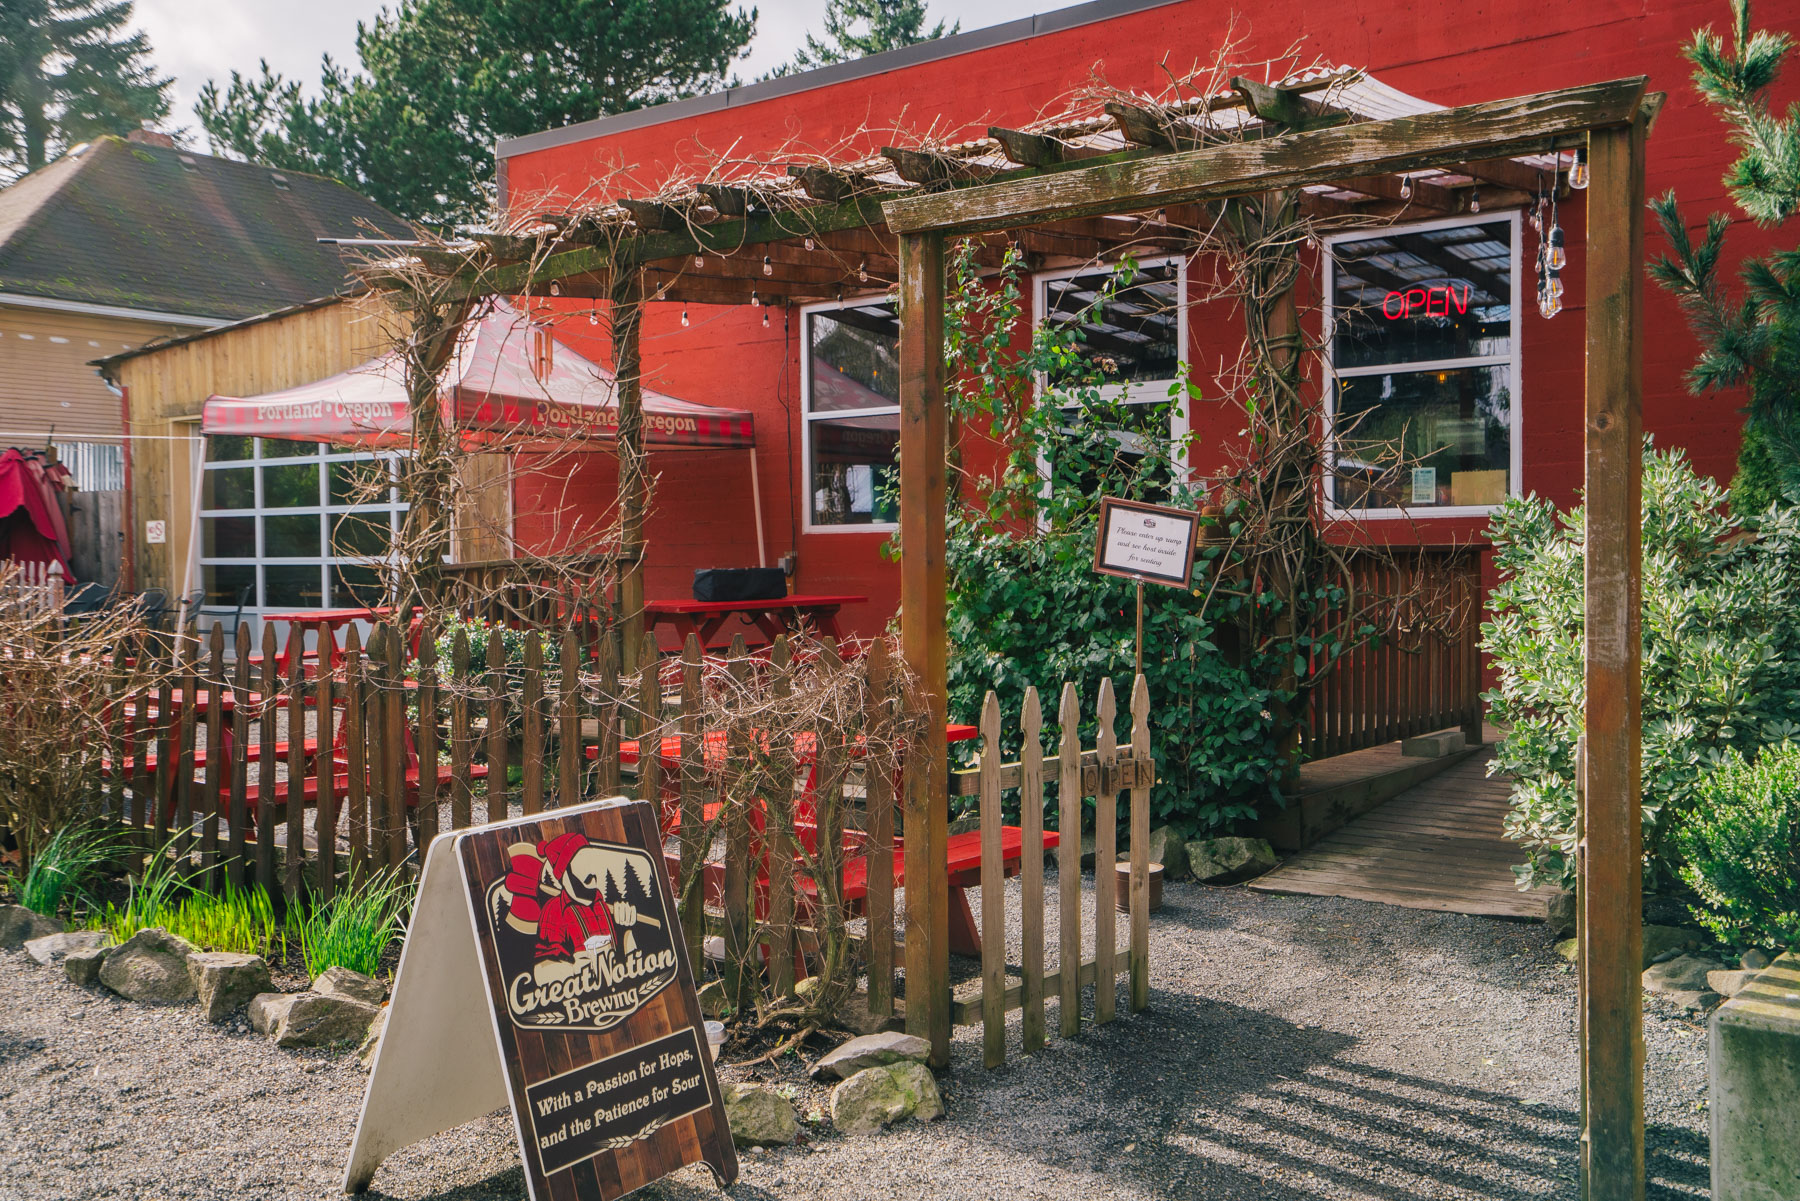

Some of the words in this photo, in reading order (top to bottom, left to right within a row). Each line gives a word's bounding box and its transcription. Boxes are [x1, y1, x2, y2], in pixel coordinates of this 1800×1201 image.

[1383, 285, 1468, 320] OPEN
[257, 401, 322, 420] Portland
[335, 402, 392, 423] Oregon
[537, 402, 619, 427] Portland
[641, 411, 697, 435] regon
[1116, 527, 1138, 537] Please
[1139, 532, 1154, 540] enter
[1165, 538, 1182, 547] ramp
[1142, 544, 1157, 553] host
[1157, 548, 1177, 556] inside
[1127, 553, 1138, 562] for
[1140, 557, 1162, 567] seating
[1086, 763, 1153, 792] OPEN
[510, 964, 596, 1015] Great
[592, 949, 677, 991] Notion
[563, 987, 640, 1025] Brewing
[536, 1091, 572, 1117] With
[574, 1090, 584, 1103] a
[586, 1069, 638, 1099] Passion
[639, 1061, 657, 1078] for
[658, 1048, 694, 1071] Hops,
[540, 1123, 568, 1149] and
[570, 1117, 592, 1137] the
[594, 1094, 650, 1127] Patience
[651, 1086, 670, 1103] for
[671, 1074, 701, 1095] Sour
